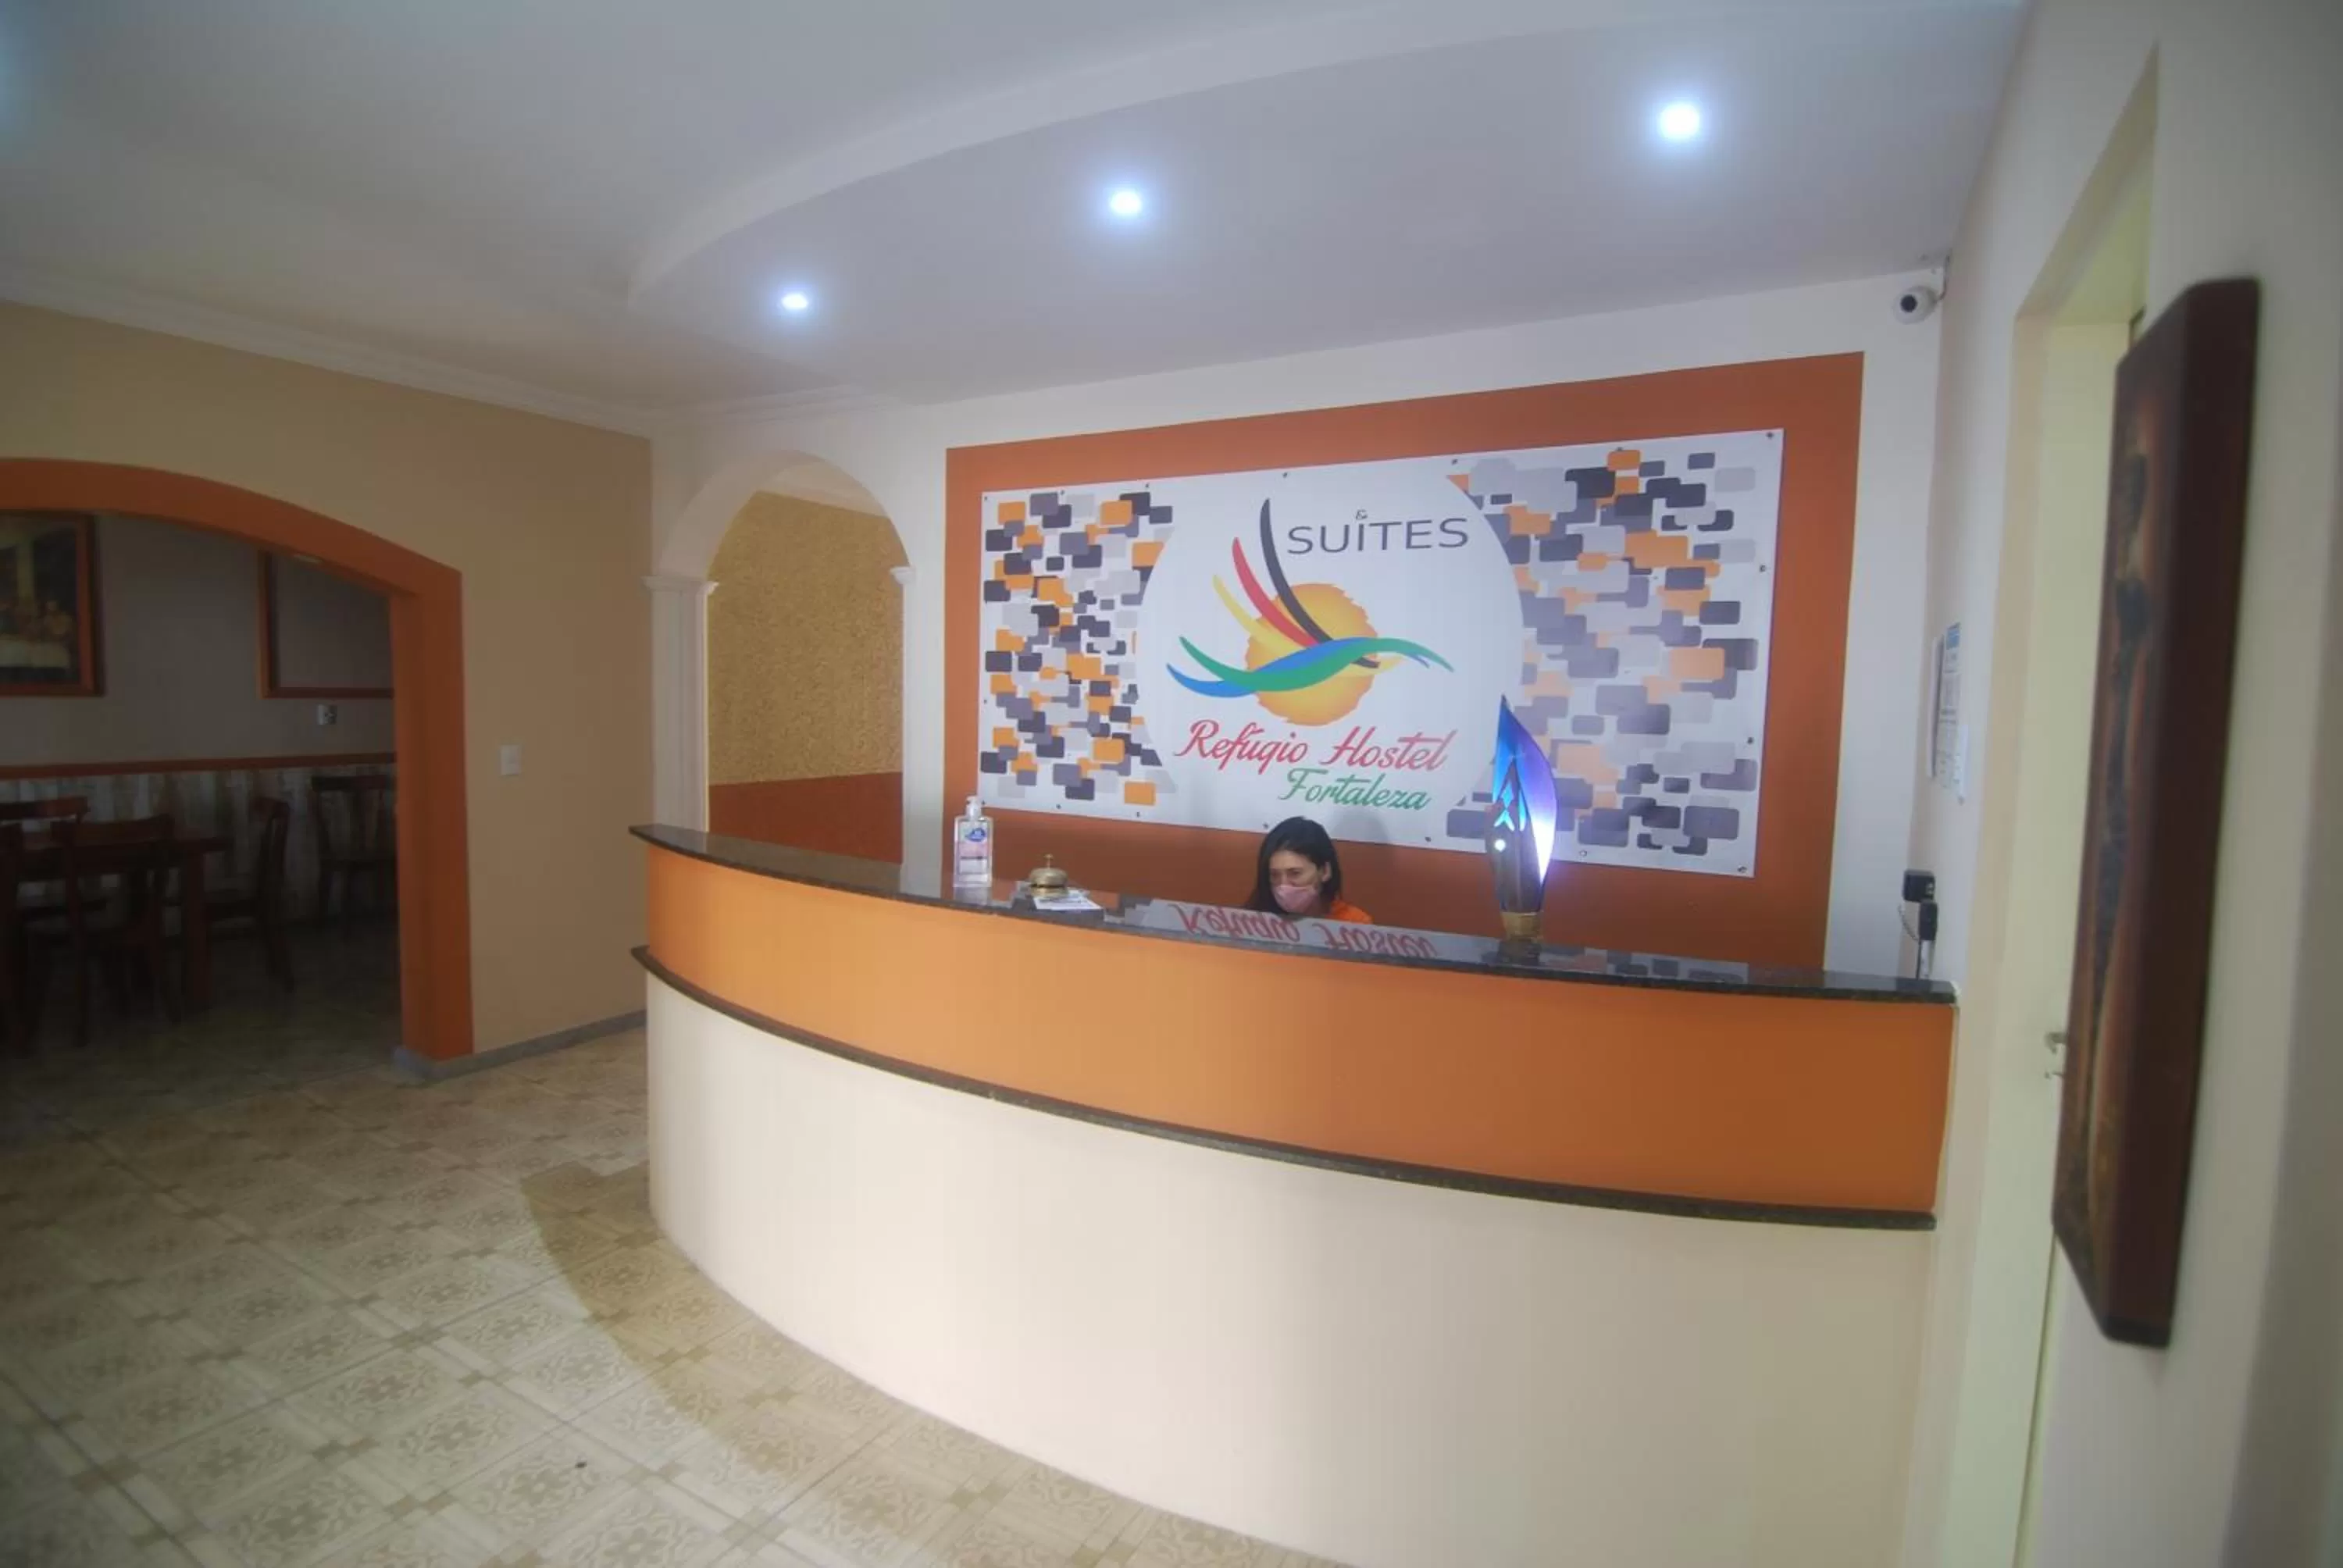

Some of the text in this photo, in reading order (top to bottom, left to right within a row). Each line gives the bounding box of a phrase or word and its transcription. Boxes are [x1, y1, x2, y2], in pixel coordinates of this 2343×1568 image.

[1287, 518, 1469, 554] SUITES
[1174, 719, 1459, 775] Refúgio Hostel
[1277, 768, 1432, 811] Fortaleza
